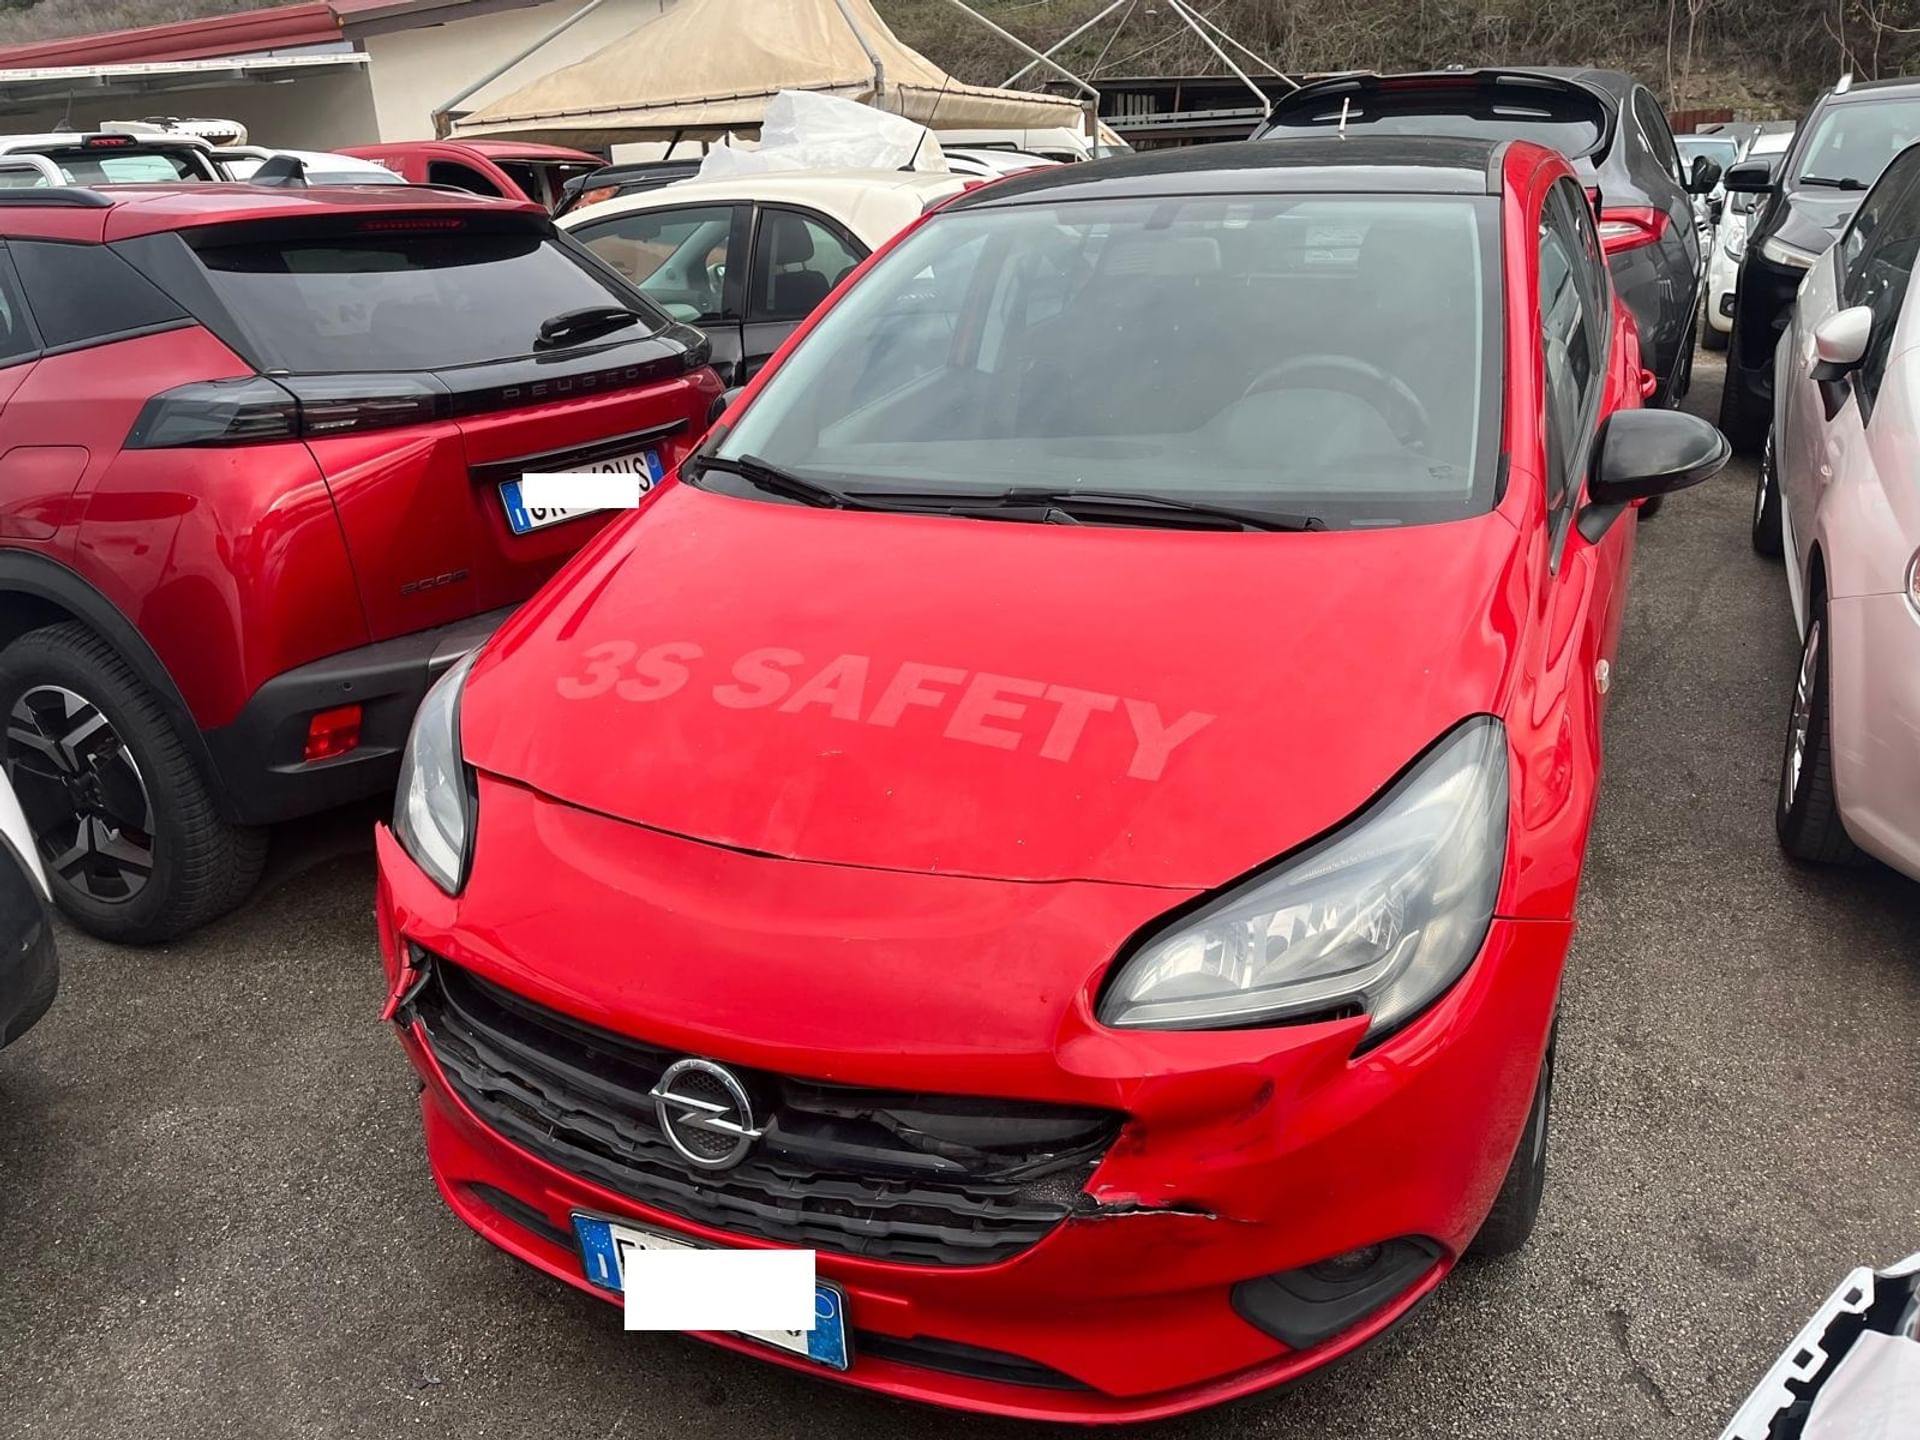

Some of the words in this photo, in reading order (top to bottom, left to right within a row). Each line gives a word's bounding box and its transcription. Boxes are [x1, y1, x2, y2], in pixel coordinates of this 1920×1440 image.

[503, 365, 656, 399] PEUGEOT
[557, 640, 703, 702] 3S
[713, 647, 1217, 781] SAFETY
